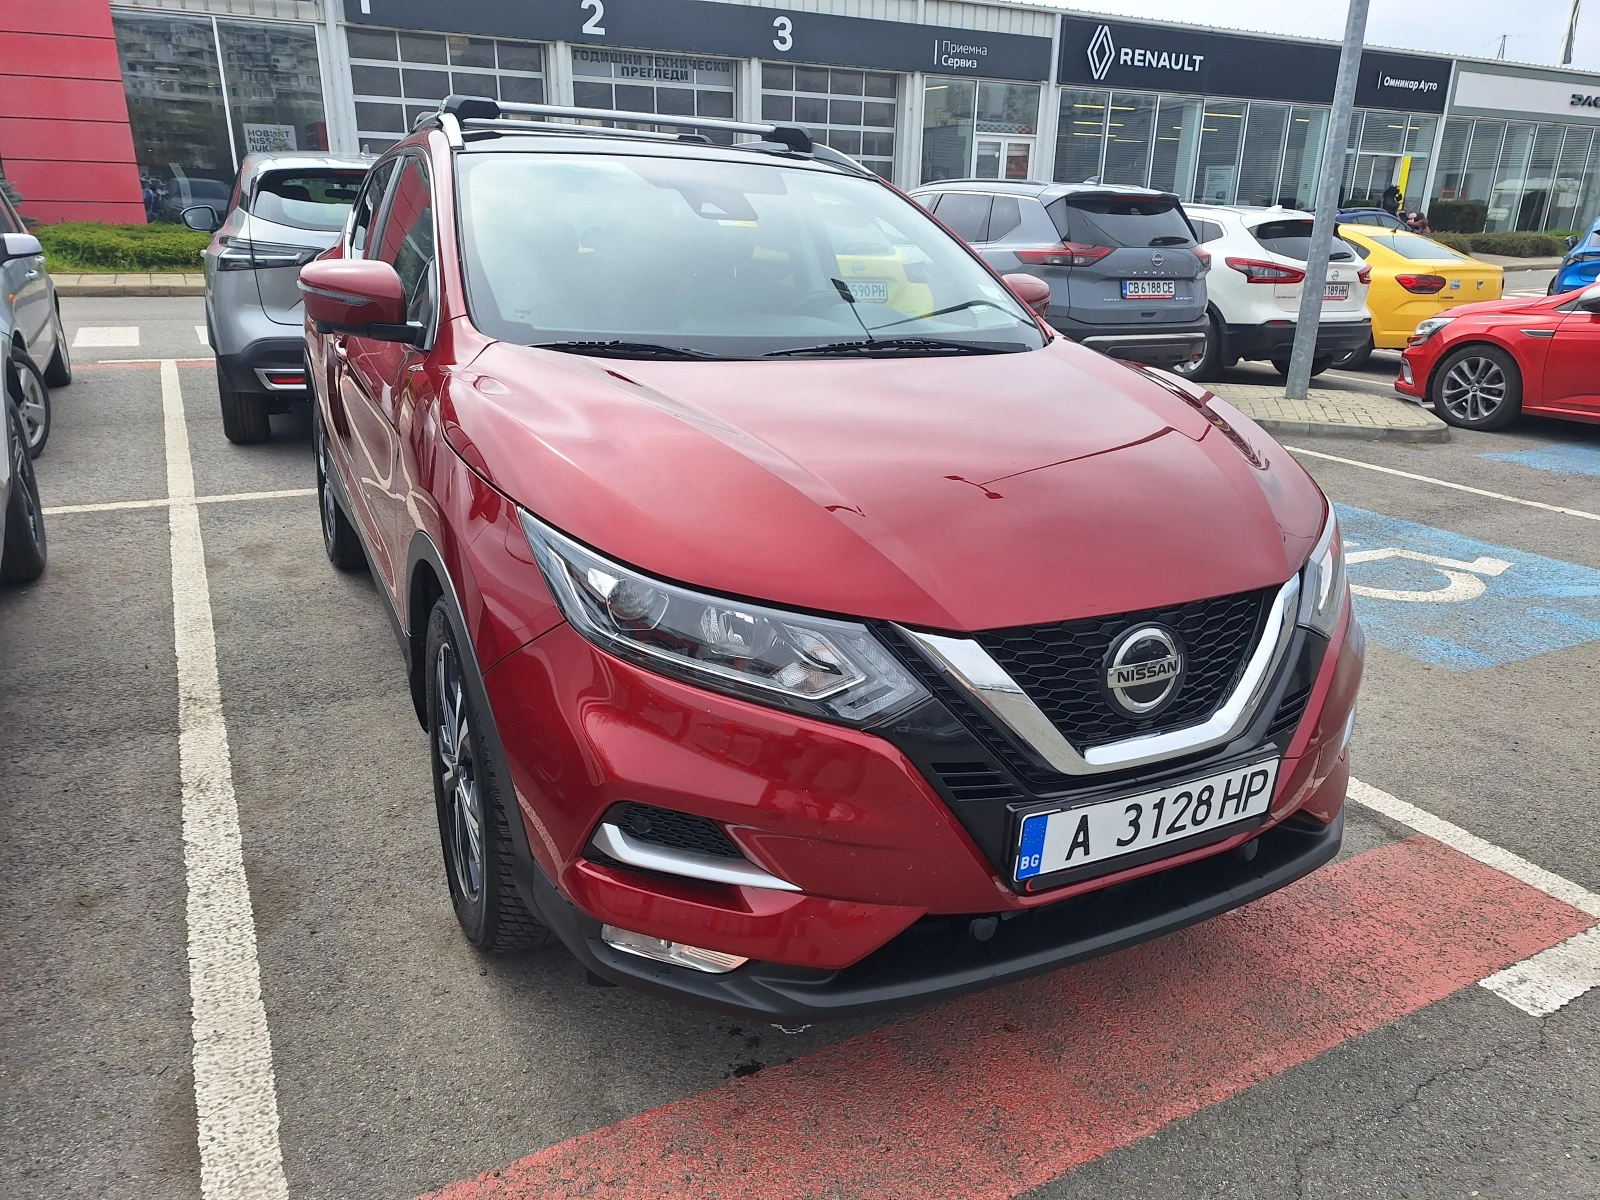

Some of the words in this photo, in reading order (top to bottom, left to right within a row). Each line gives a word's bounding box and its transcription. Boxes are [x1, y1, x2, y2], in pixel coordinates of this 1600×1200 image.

[580, 0, 606, 36] 2
[772, 16, 793, 51] 3
[942, 40, 988, 56] Приемна
[573, 50, 642, 66] ГОДИШНИ
[646, 55, 730, 73] ТЕХНИЧЕСКИ
[941, 54, 978, 69] Сервиз
[1119, 47, 1204, 72] RENAULT
[621, 65, 689, 81] ПРЕГЛЕДИ
[1383, 76, 1419, 91] Омникар
[1419, 79, 1438, 91] Ауто
[872, 284, 886, 297] PH
[1128, 282, 1140, 293] CB
[1141, 282, 1161, 293] 6188
[1162, 282, 1174, 293] CE
[1117, 660, 1177, 684] NISSAN
[1064, 814, 1091, 862] A
[1116, 784, 1215, 847] 3128
[1217, 769, 1269, 820] HP
[1020, 853, 1040, 871] BG
